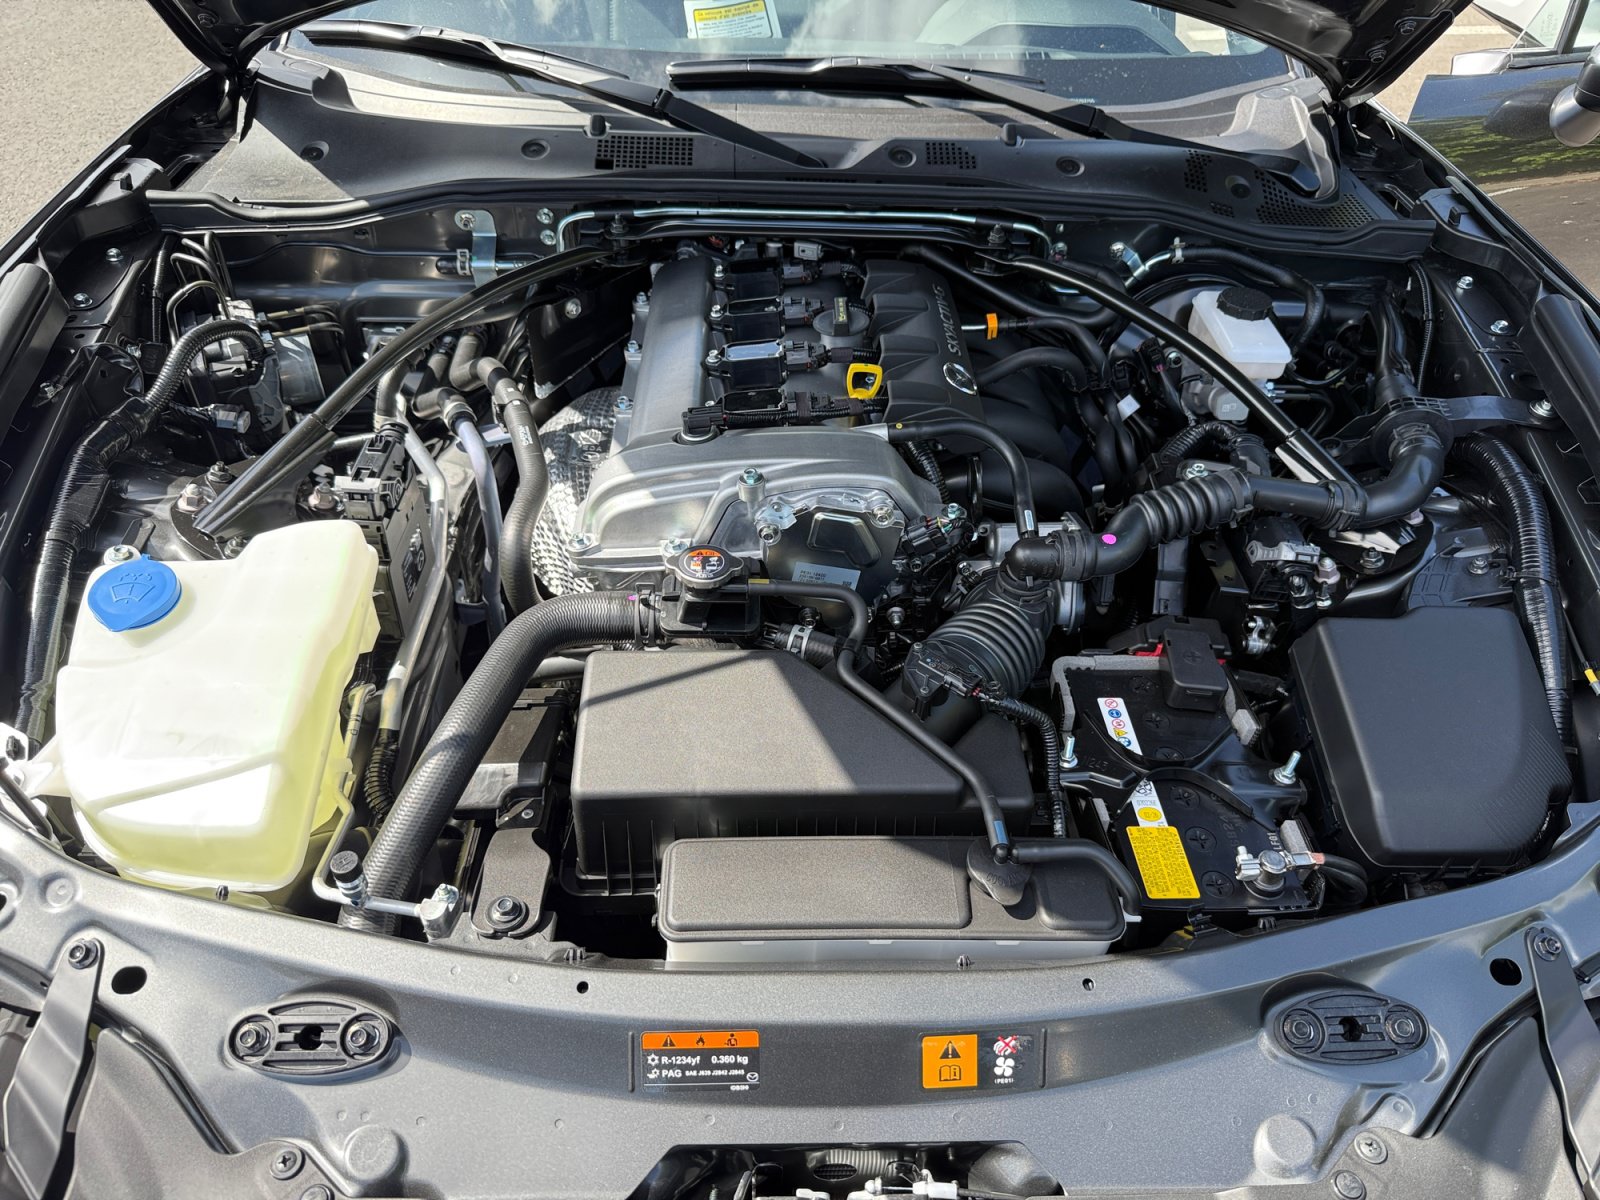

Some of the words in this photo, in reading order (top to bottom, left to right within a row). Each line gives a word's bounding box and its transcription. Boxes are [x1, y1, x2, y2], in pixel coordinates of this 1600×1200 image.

[932, 283, 961, 357] SKYACTIV-G
[661, 1055, 700, 1066] R-1234yf
[736, 1055, 749, 1065] kg
[661, 1069, 682, 1078] PAG
